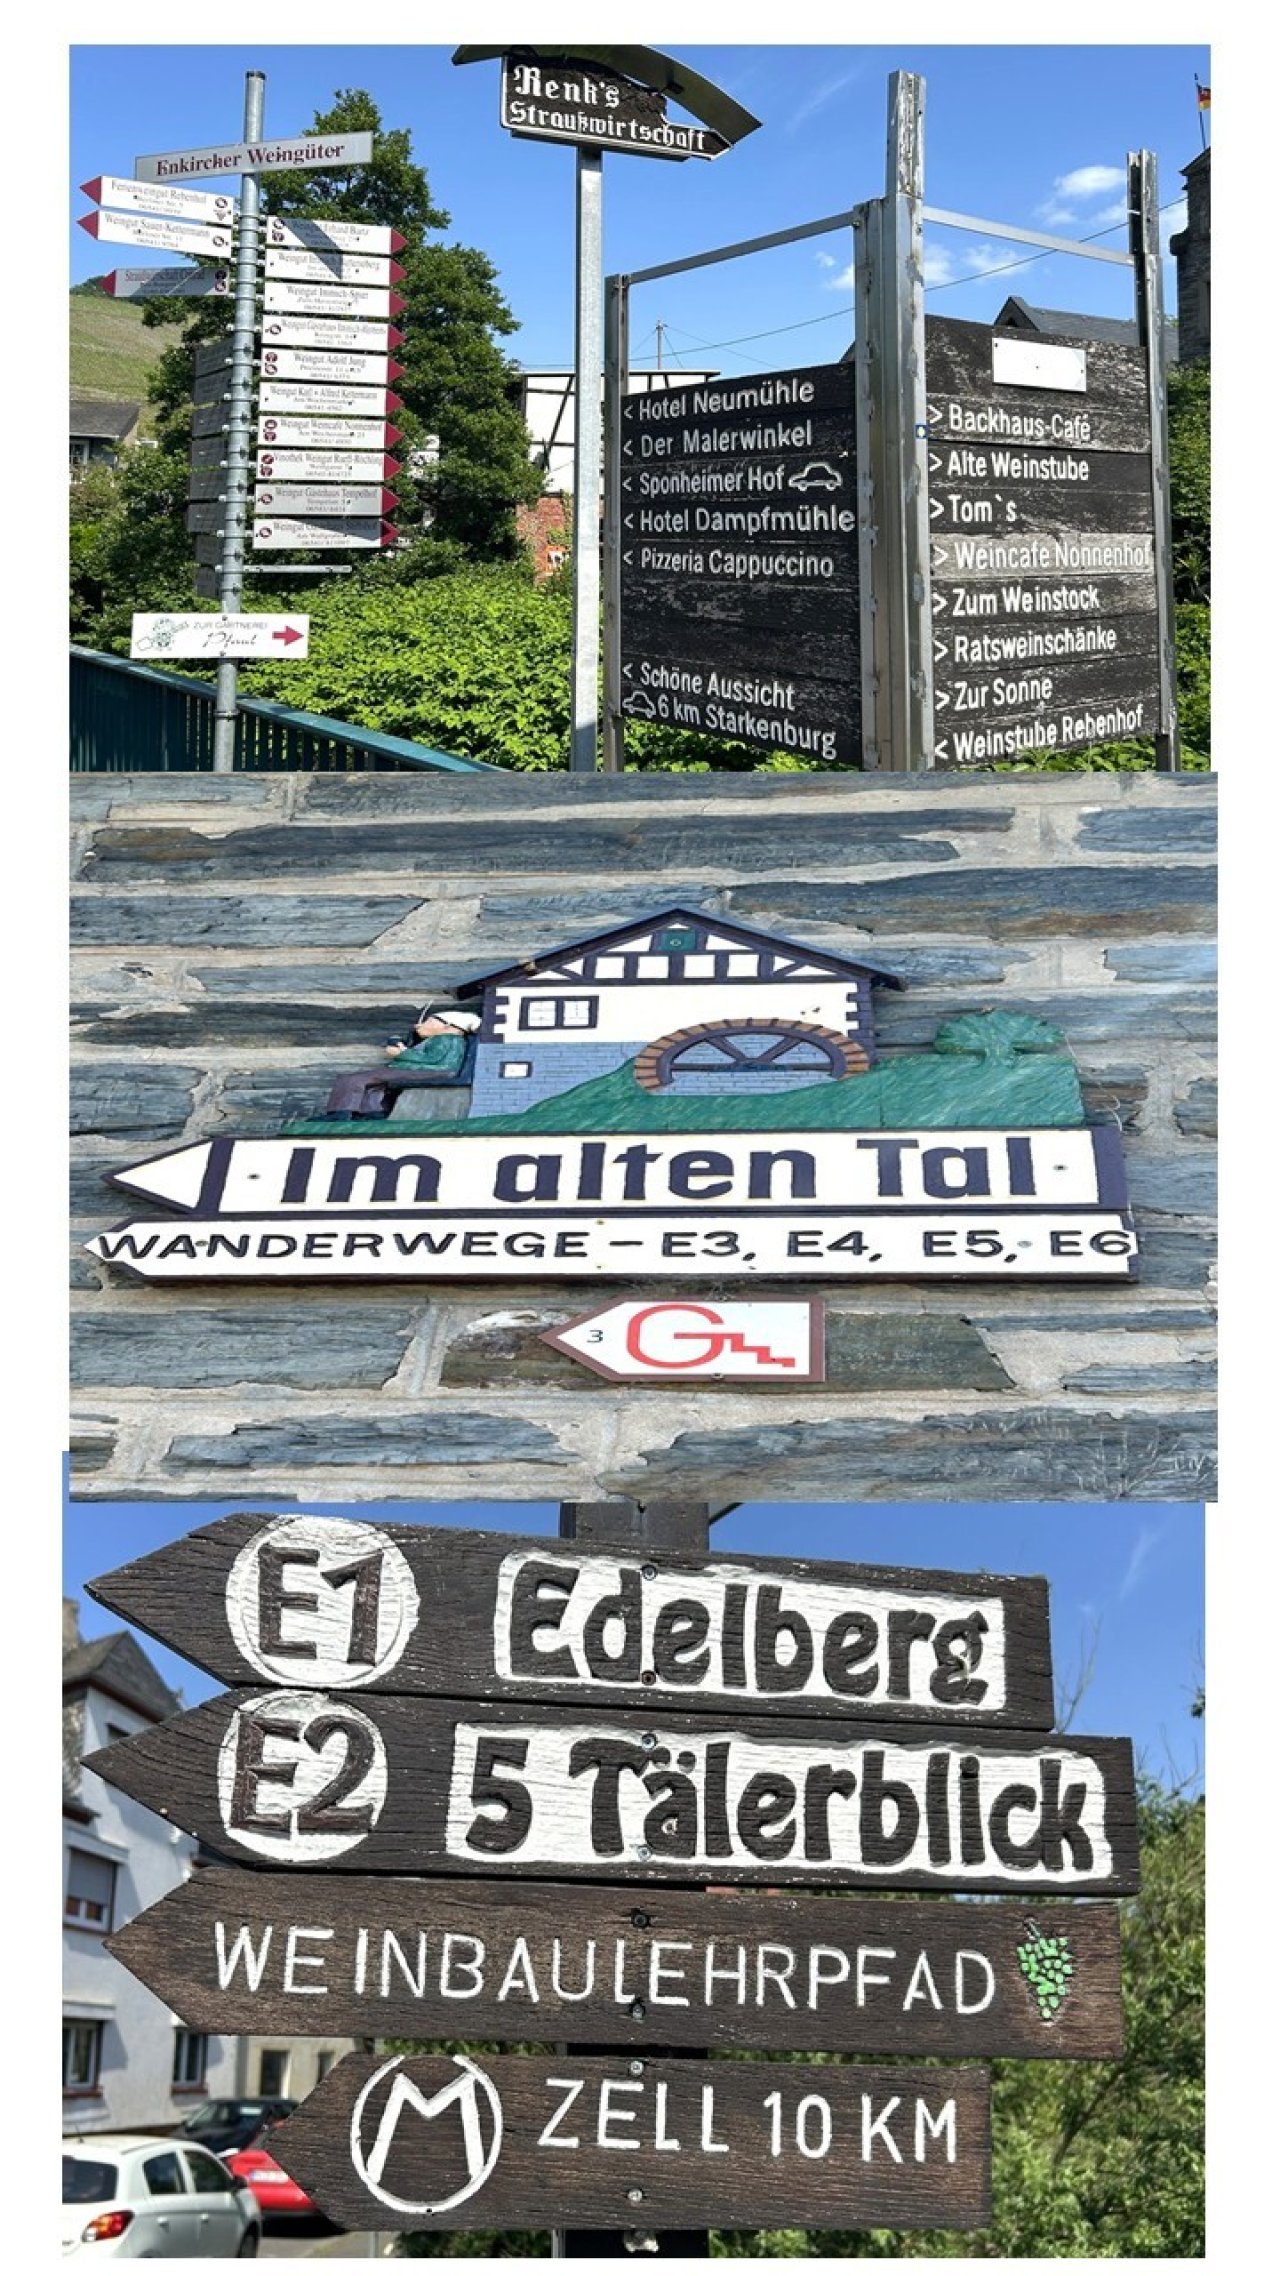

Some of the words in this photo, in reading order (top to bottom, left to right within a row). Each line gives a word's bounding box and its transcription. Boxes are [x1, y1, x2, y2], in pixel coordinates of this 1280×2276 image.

[513, 64, 620, 109] Renk's
[510, 100, 706, 151] Straußwirtschaft
[156, 152, 242, 177] Enkircher
[247, 143, 345, 166] Weingüter
[639, 394, 686, 421] Hotel
[693, 378, 815, 415] Neumühle
[641, 434, 673, 458] Der
[683, 419, 812, 454] Malerwinkel
[949, 402, 1091, 441] Backhaus-Café
[639, 469, 744, 499] Sponheimer
[747, 463, 785, 491] Hof
[947, 450, 987, 477] Alte
[991, 450, 1089, 481] Weinstube
[640, 507, 689, 533] Hotel
[696, 504, 856, 536] Dampfmühle
[641, 547, 703, 574] Pizzeria
[708, 548, 834, 578] Cappuccino
[1055, 541, 1152, 567] Nonnenhof
[952, 588, 998, 617] Zum
[1002, 584, 1100, 614] Weinstock
[954, 625, 1118, 663] Ratsweinschänke
[641, 661, 703, 694] Schöne
[707, 671, 796, 712] Aussicht
[954, 681, 988, 712] Zur
[993, 677, 1054, 707] Sonne
[657, 693, 670, 719] 6
[673, 697, 701, 726] km
[705, 703, 837, 760] Starkenburg
[953, 718, 1057, 762] Weinstube
[1061, 703, 1144, 743] Rebenhof
[280, 1146, 442, 1204] Im
[493, 1141, 817, 1204] alten
[856, 1136, 1038, 1200] Tal
[99, 1230, 590, 1260] WANDERWEGE
[661, 1231, 757, 1262] E3,
[786, 1230, 884, 1262] E4,
[922, 1230, 1018, 1263] E5,
[1048, 1230, 1131, 1257] E6
[586, 1329, 604, 1343] 3
[257, 1541, 385, 1668] E1
[510, 1559, 990, 1706] Edelberg
[228, 1711, 376, 1840] E2
[465, 1735, 533, 1856] 5
[569, 1737, 1094, 1873] Tälerblick
[214, 1921, 996, 2016] WEINBAULEHRPFAD
[537, 2079, 729, 2153] ZELL
[763, 2089, 833, 2160] 10
[861, 2092, 958, 2164] KM
